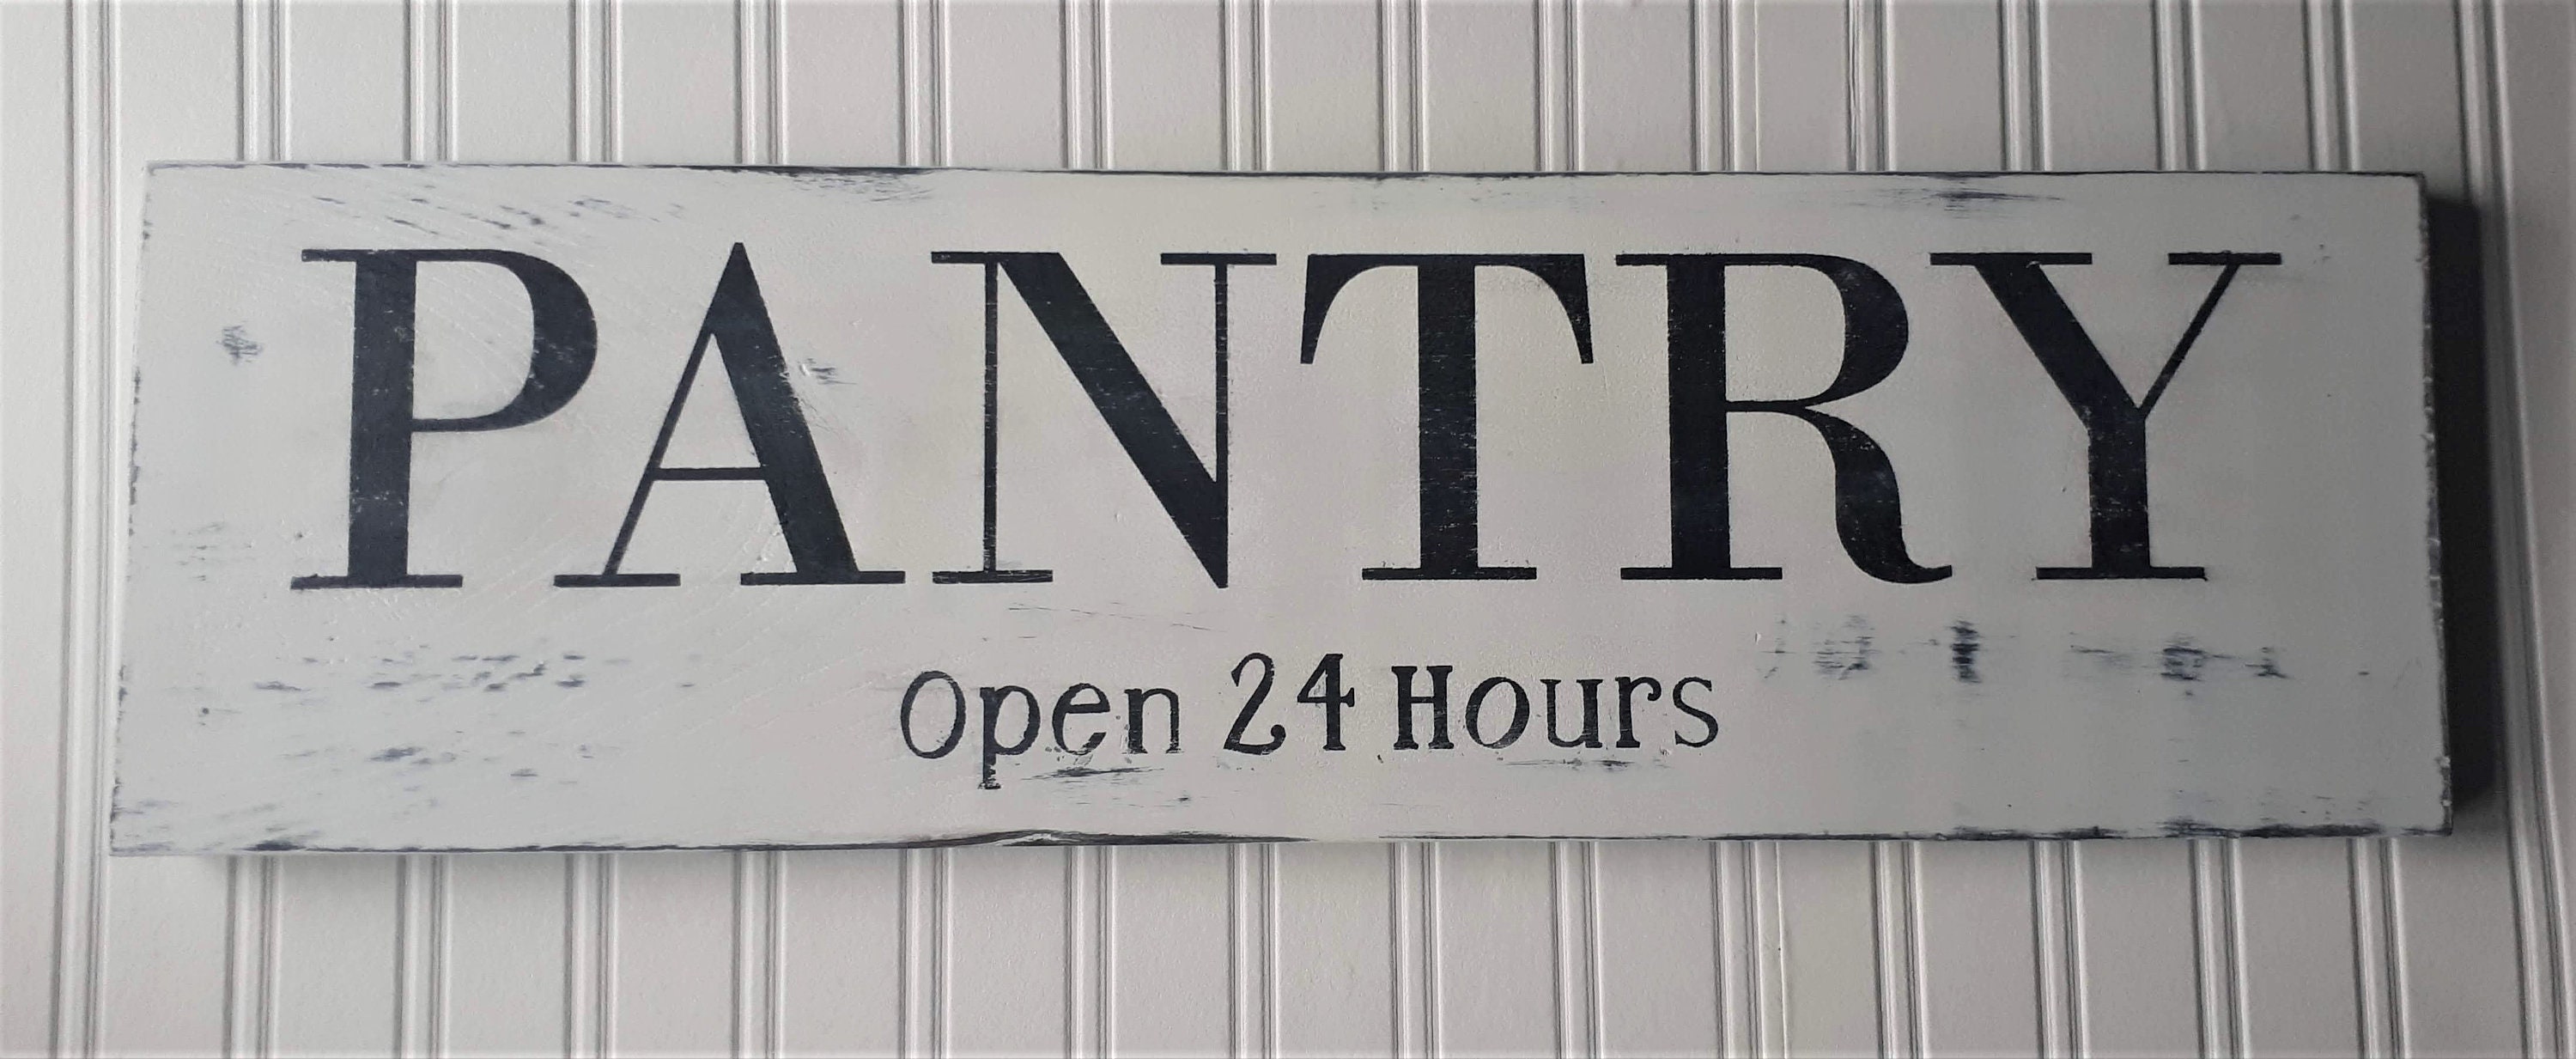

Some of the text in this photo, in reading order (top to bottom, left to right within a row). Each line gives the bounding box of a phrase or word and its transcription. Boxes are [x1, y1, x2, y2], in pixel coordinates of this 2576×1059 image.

[290, 241, 2283, 590] PANTRY
[899, 651, 1720, 791] Open 24 Hours
